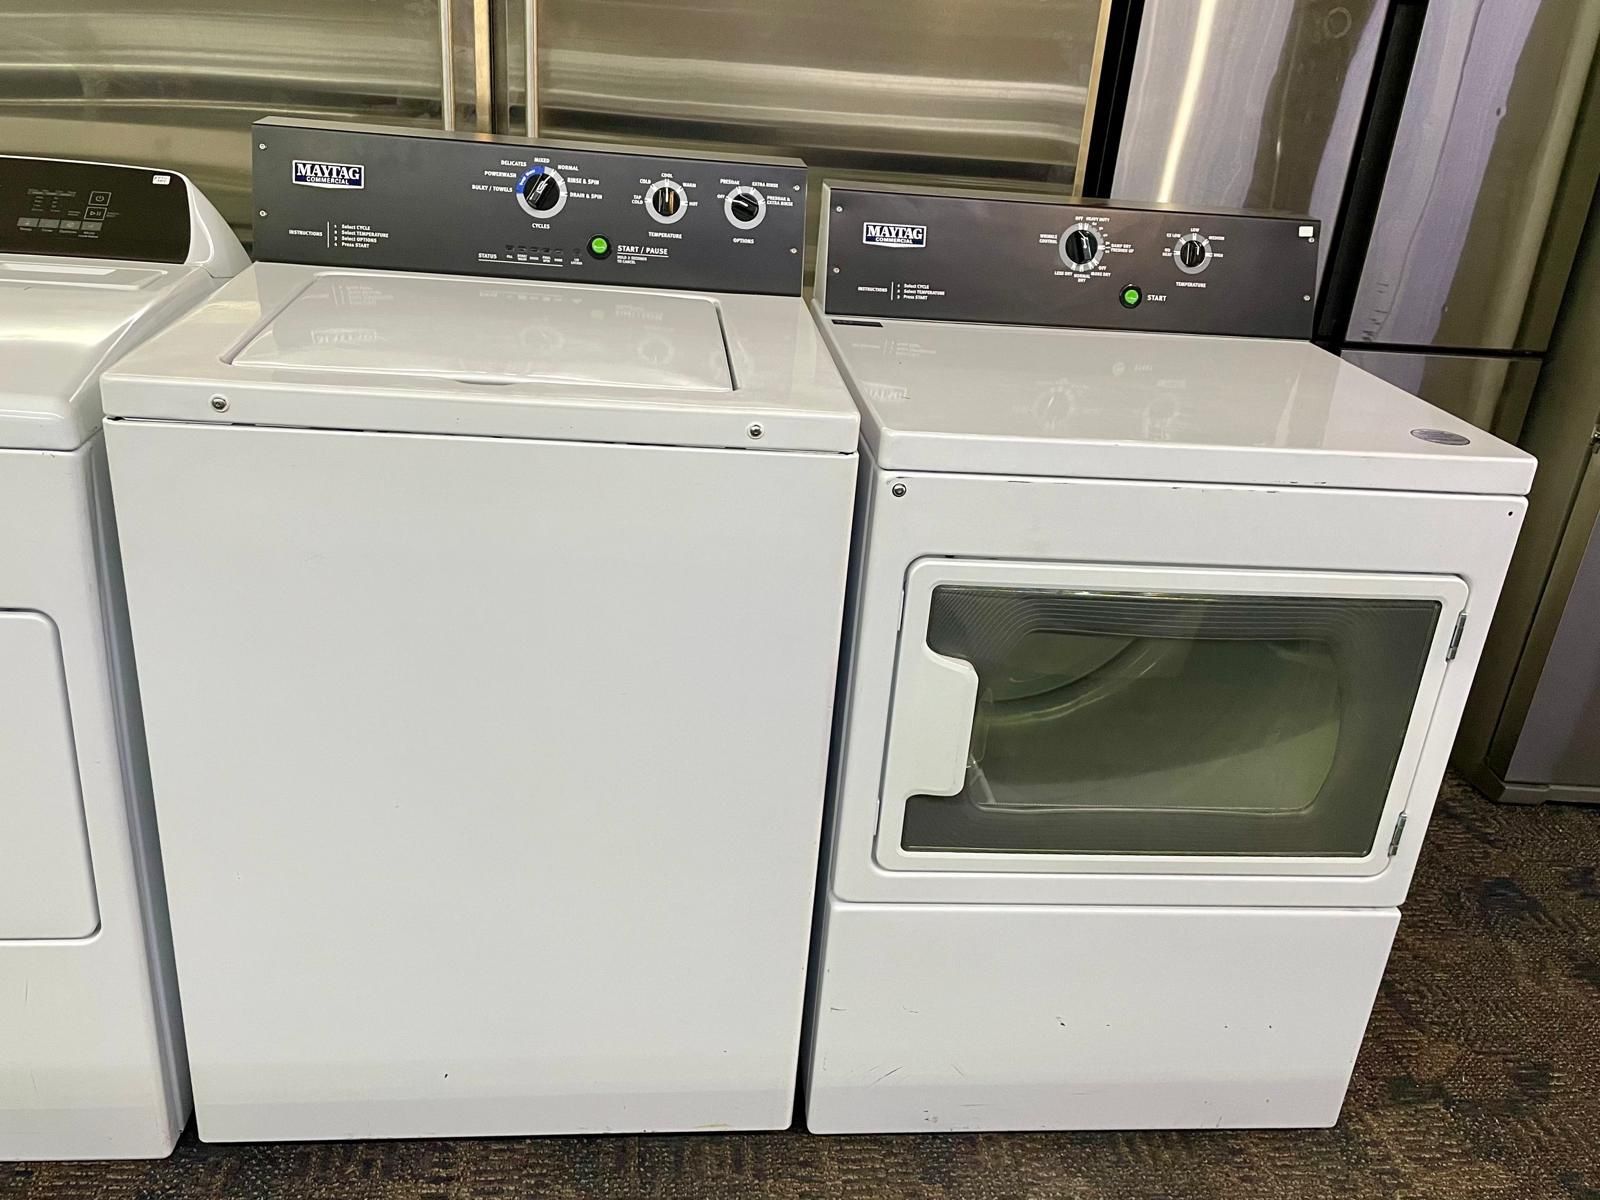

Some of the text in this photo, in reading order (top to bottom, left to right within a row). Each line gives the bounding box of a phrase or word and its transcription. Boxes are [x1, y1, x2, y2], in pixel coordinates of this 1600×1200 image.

[297, 163, 360, 180] MAYTAG
[306, 176, 350, 185] COMMERCIAL
[288, 229, 323, 237] INSTRUCTIONS
[648, 231, 682, 239] TEMPERATURE
[866, 225, 923, 240] MAYTAG
[875, 236, 913, 244] COMMERCIAL
[646, 247, 668, 255] PAUSE
